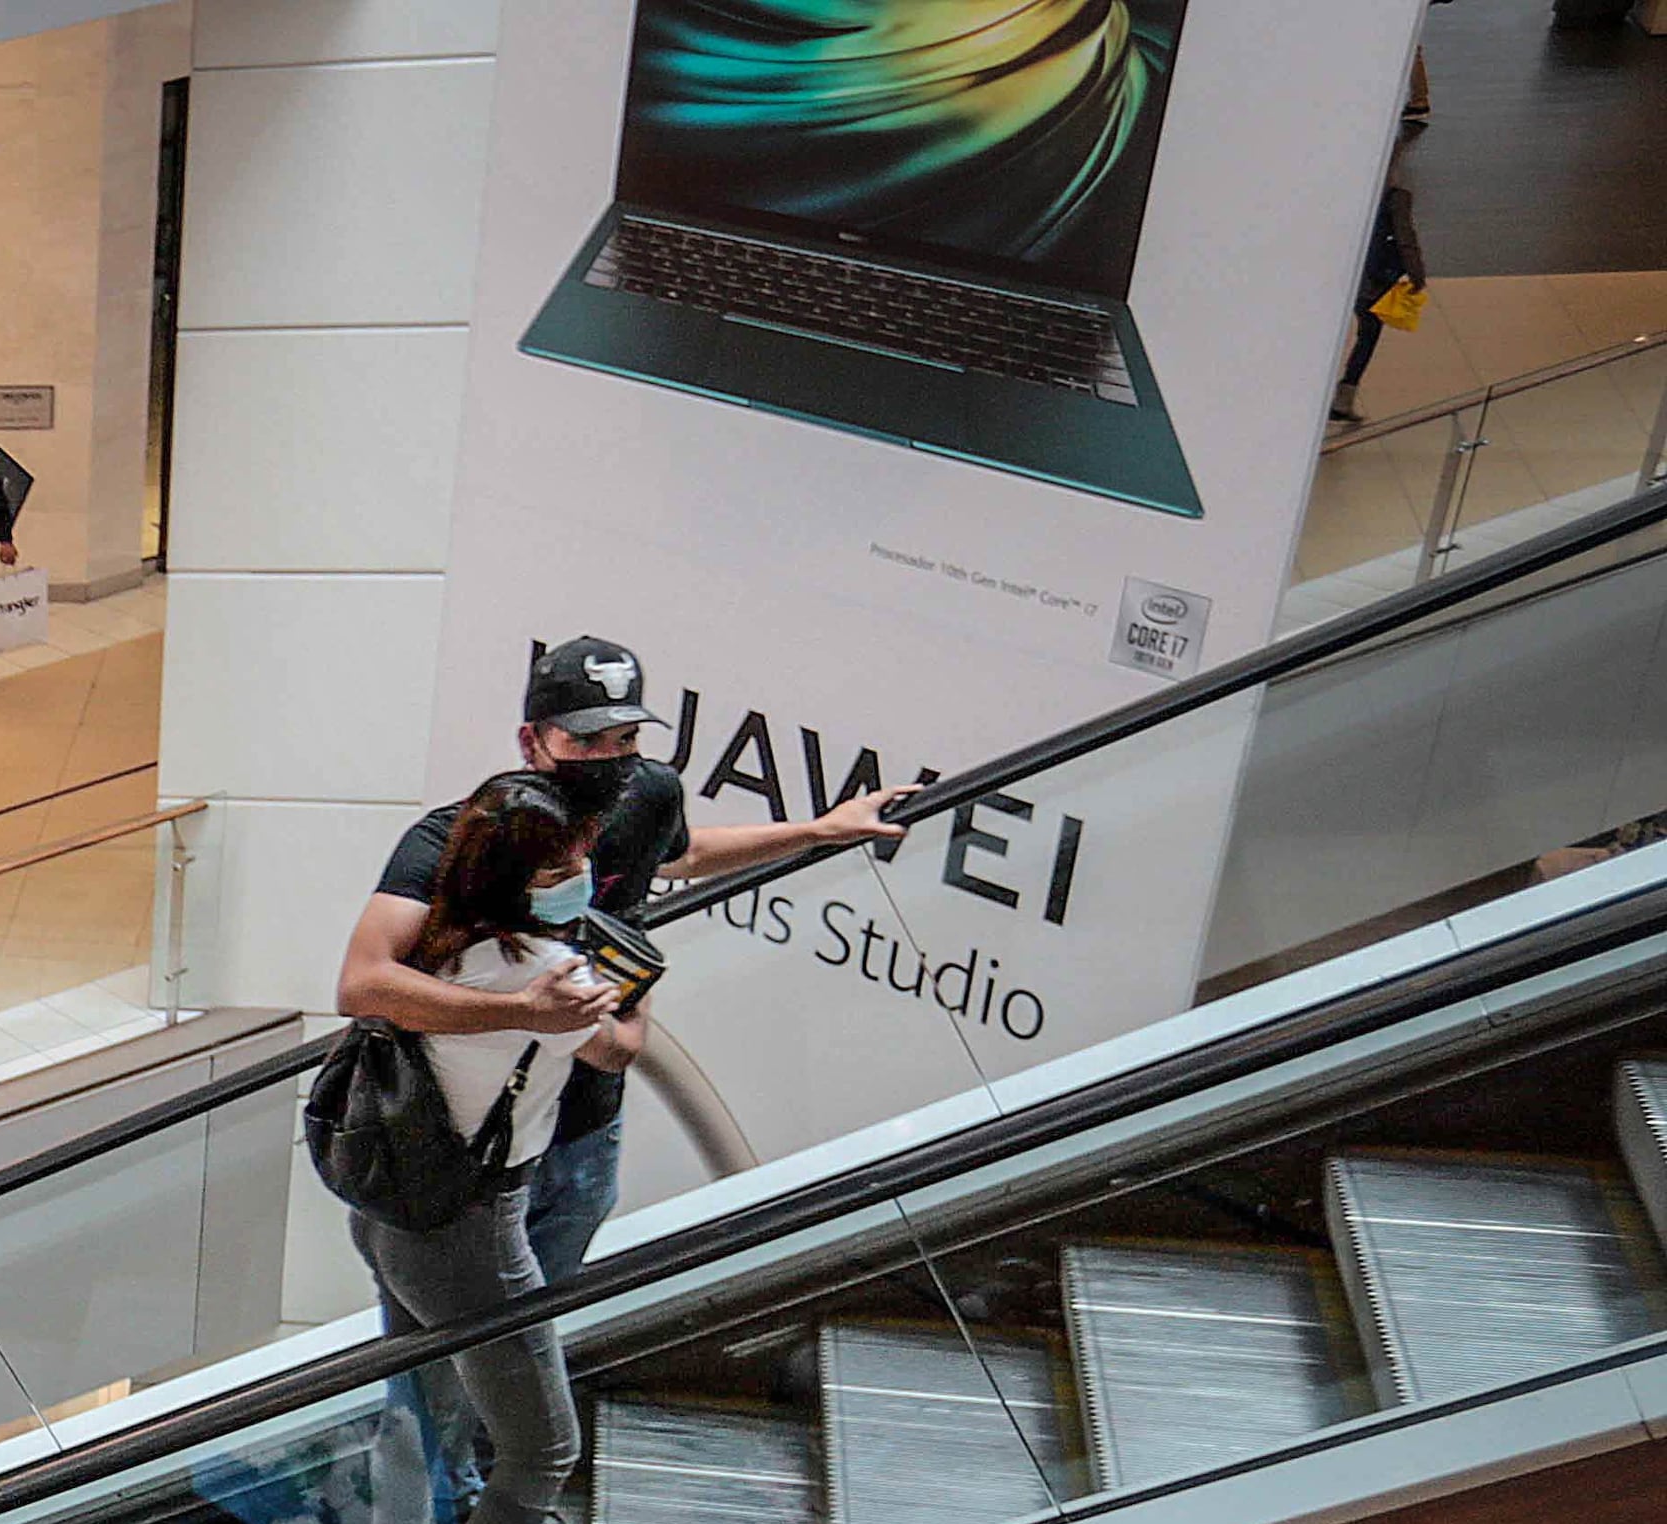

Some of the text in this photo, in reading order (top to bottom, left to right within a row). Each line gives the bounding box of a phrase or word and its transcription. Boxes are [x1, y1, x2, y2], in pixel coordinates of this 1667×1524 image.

[970, 571, 997, 588] Gen
[1127, 622, 1169, 654] CORE
[814, 902, 1044, 1040] Studio
